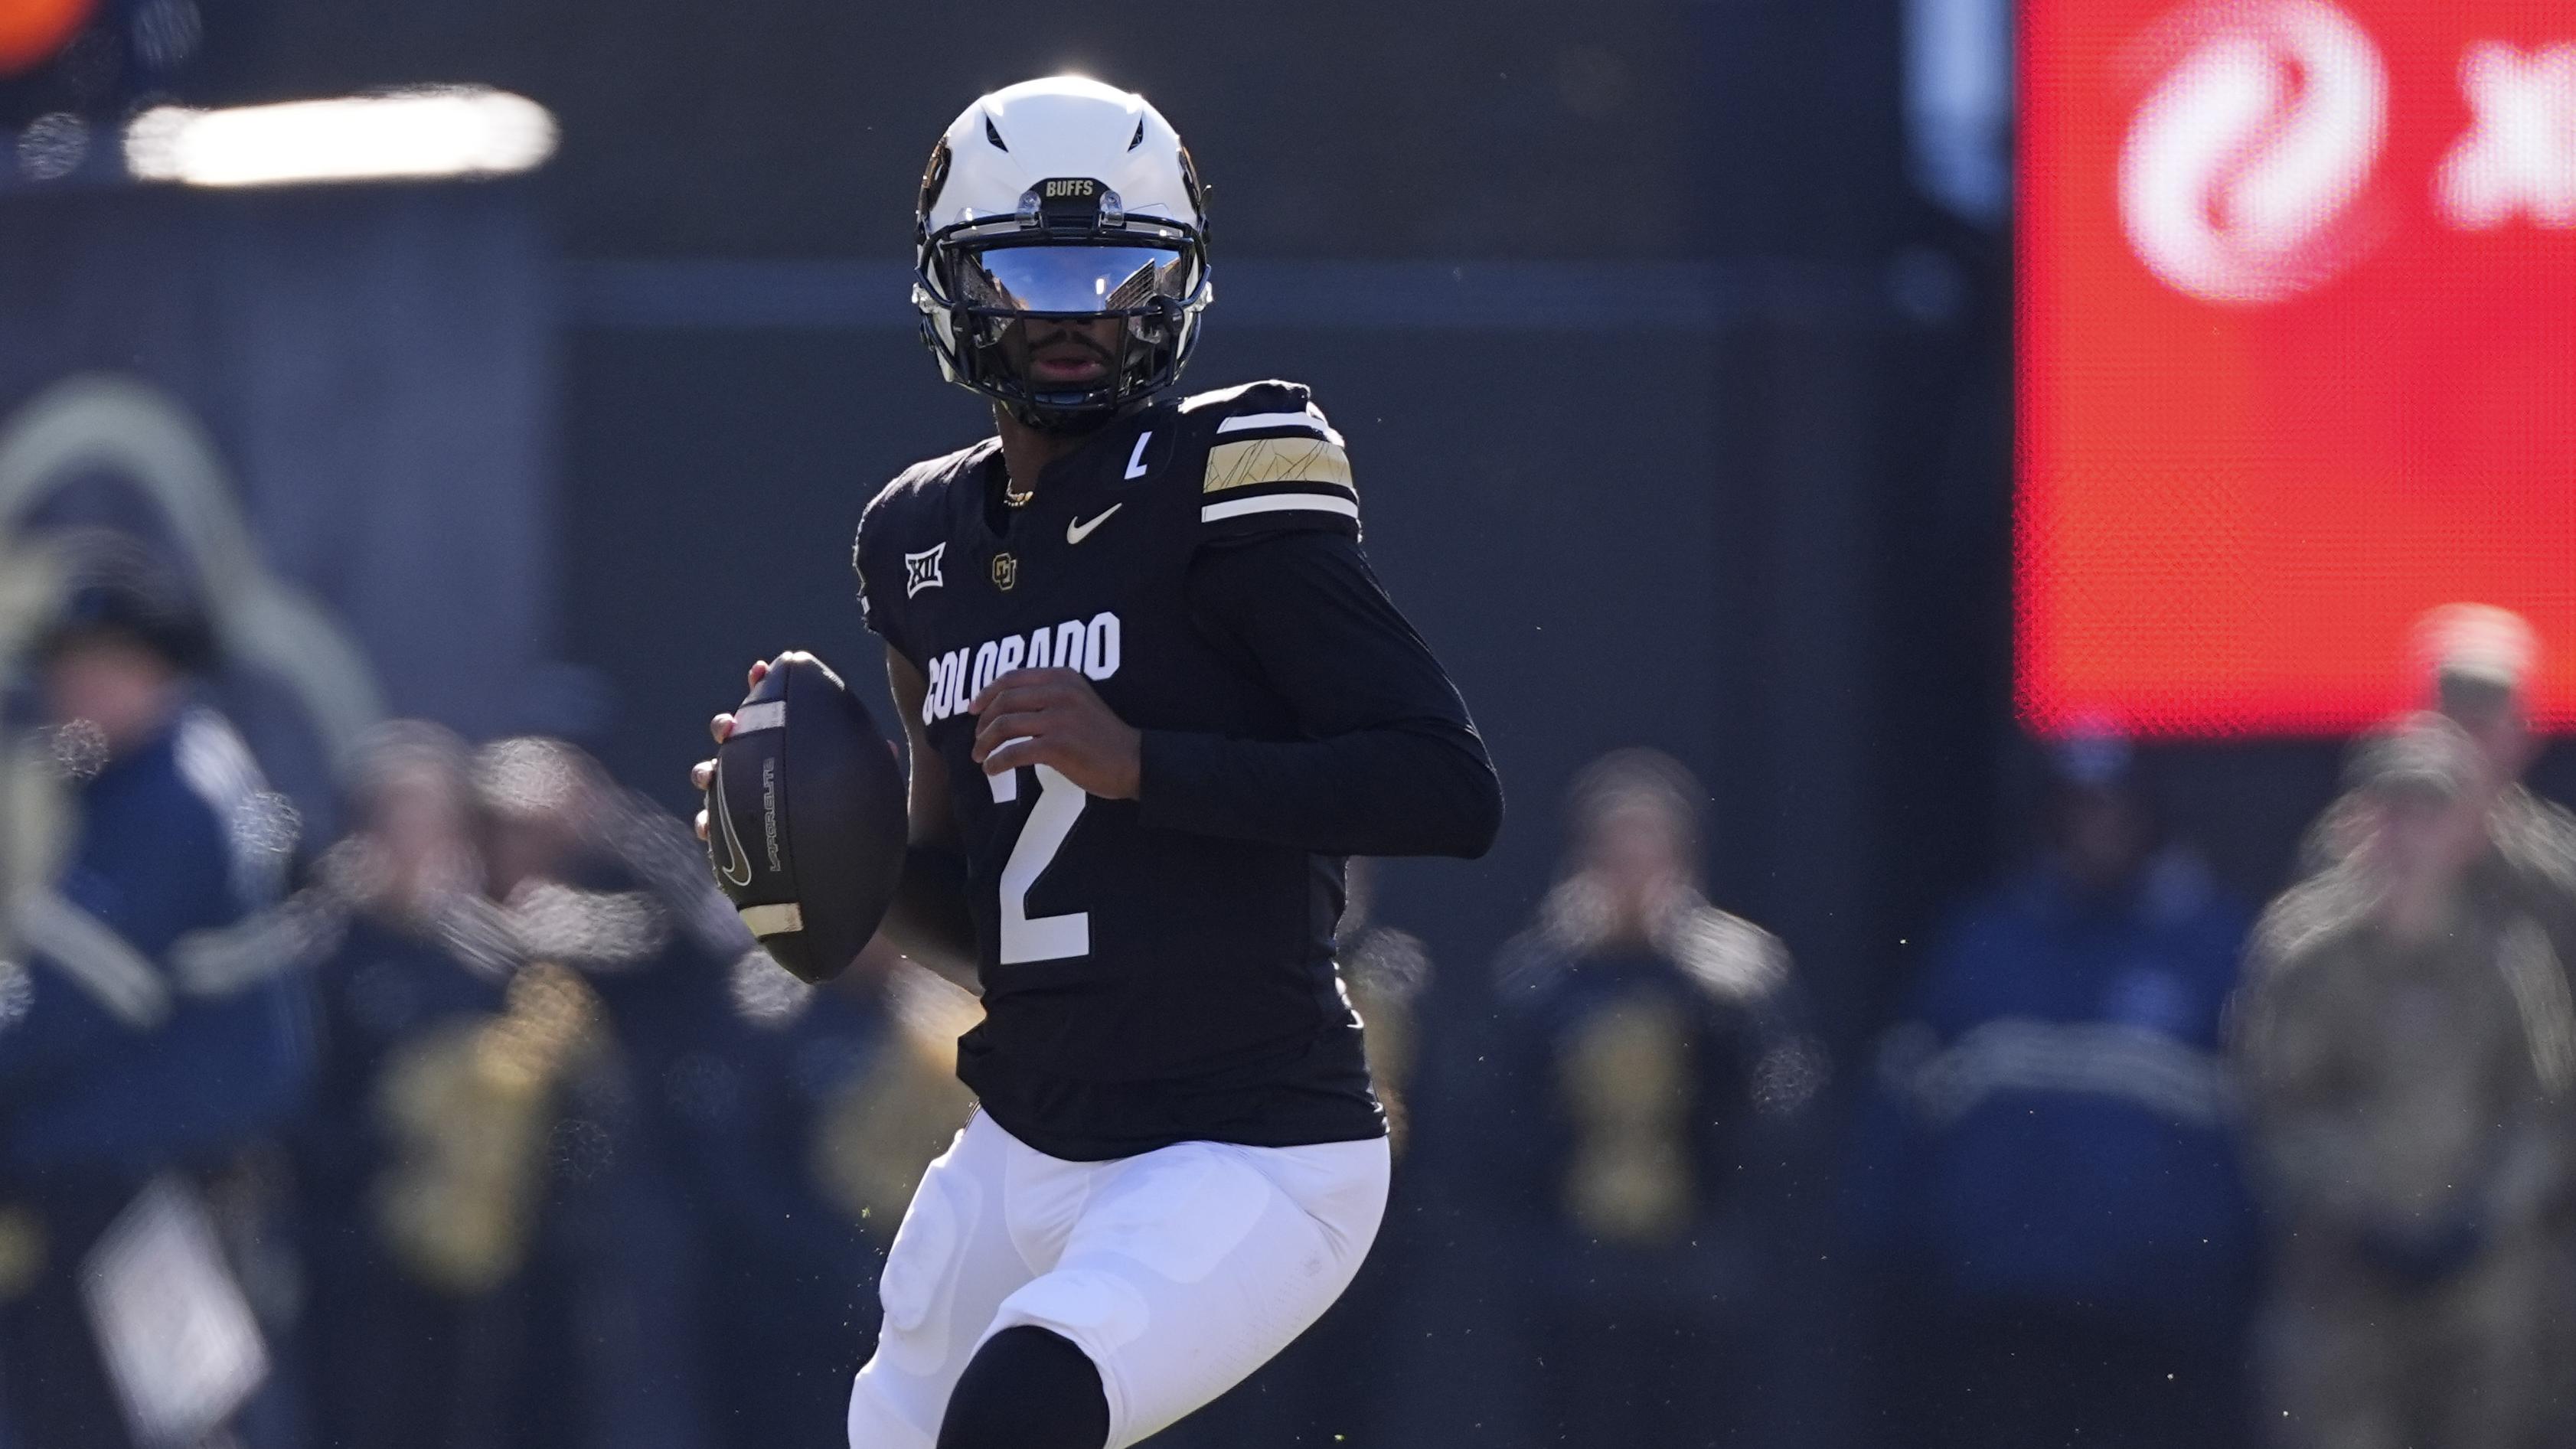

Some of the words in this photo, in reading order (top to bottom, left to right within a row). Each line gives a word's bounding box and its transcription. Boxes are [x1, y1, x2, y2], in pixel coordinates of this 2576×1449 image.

[1046, 180, 1094, 197] BUFFS
[1124, 431, 1153, 480] L
[922, 611, 1120, 726] COLORADO
[986, 736, 1089, 964] 2
